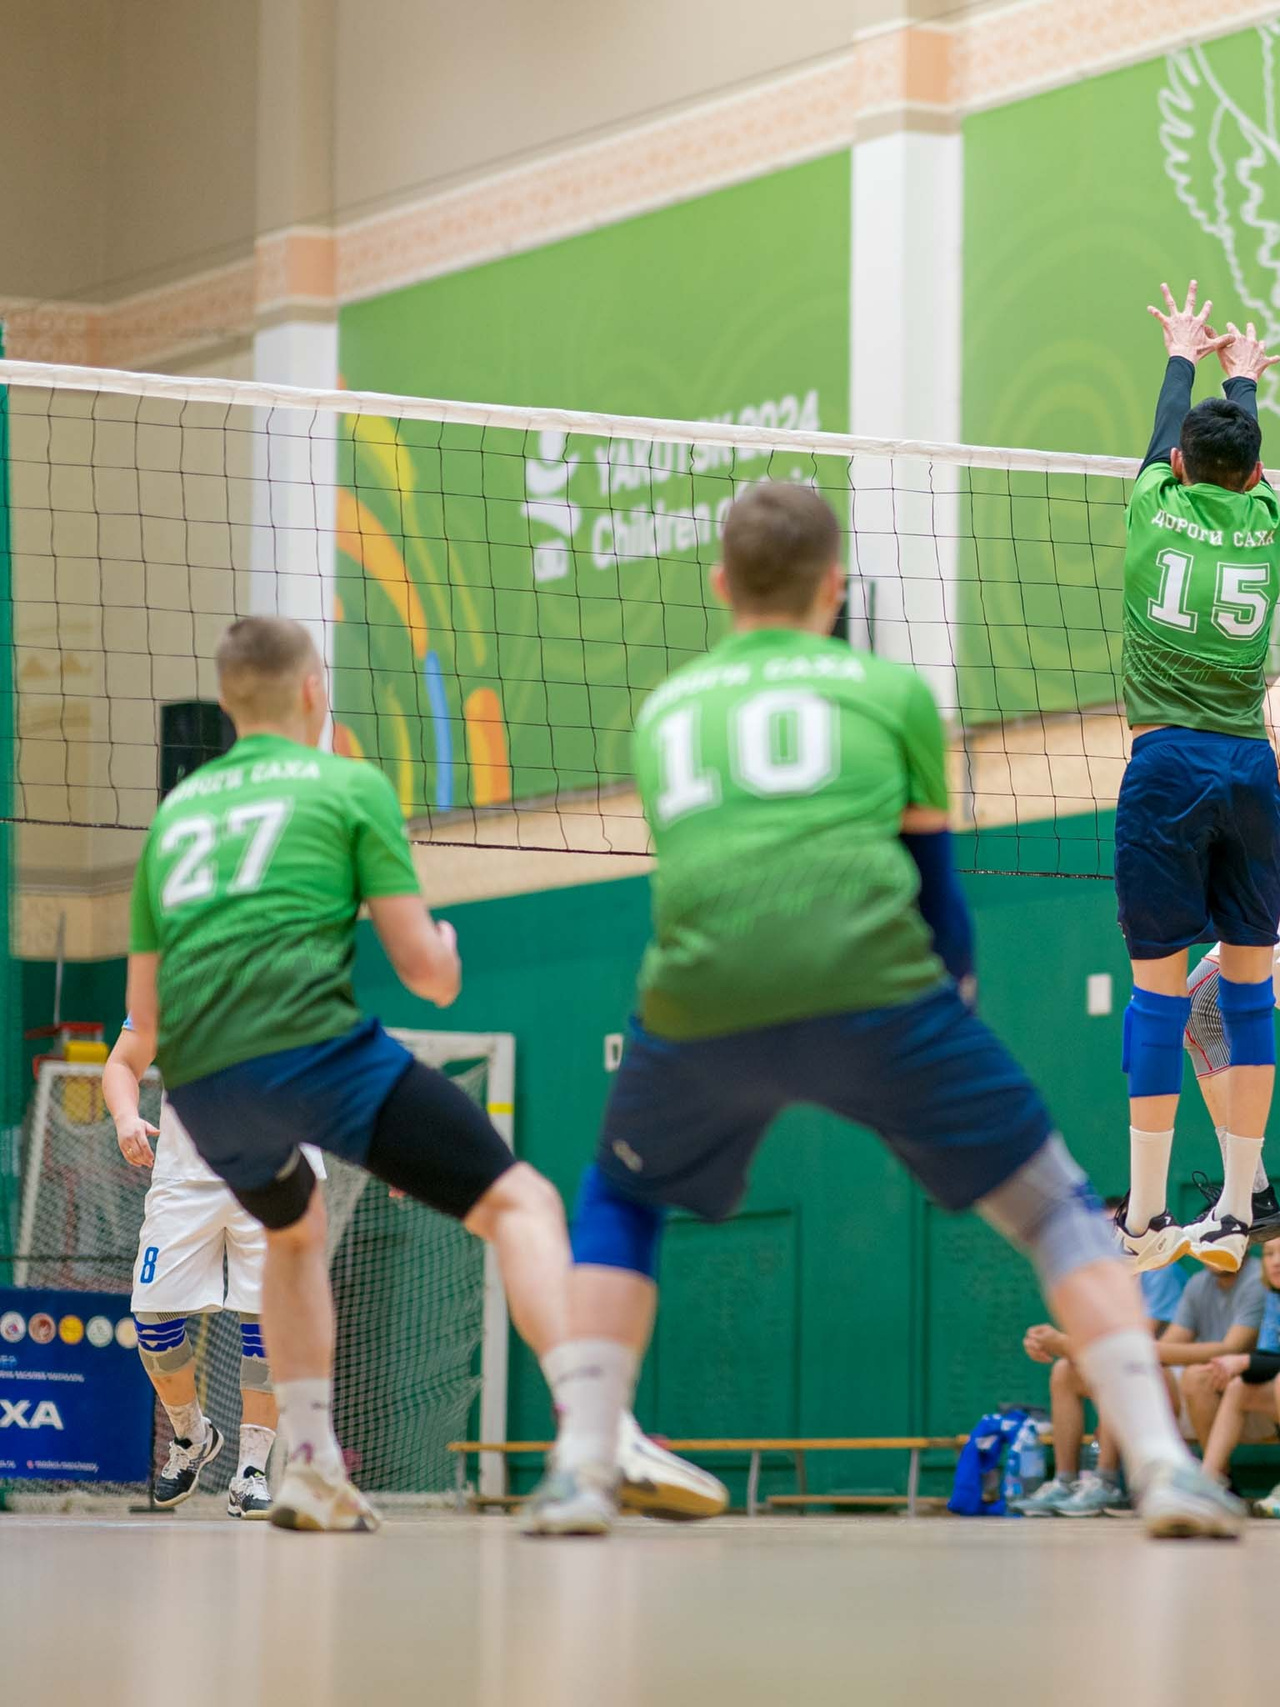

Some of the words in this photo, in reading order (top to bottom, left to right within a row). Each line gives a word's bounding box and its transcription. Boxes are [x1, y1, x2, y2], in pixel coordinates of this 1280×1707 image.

[592, 496, 711, 570] Children
[1152, 510, 1223, 545] ДОРОГИ
[1148, 548, 1270, 640] 15
[654, 689, 837, 829] 10
[160, 798, 294, 912] 27
[140, 1246, 159, 1284] 8
